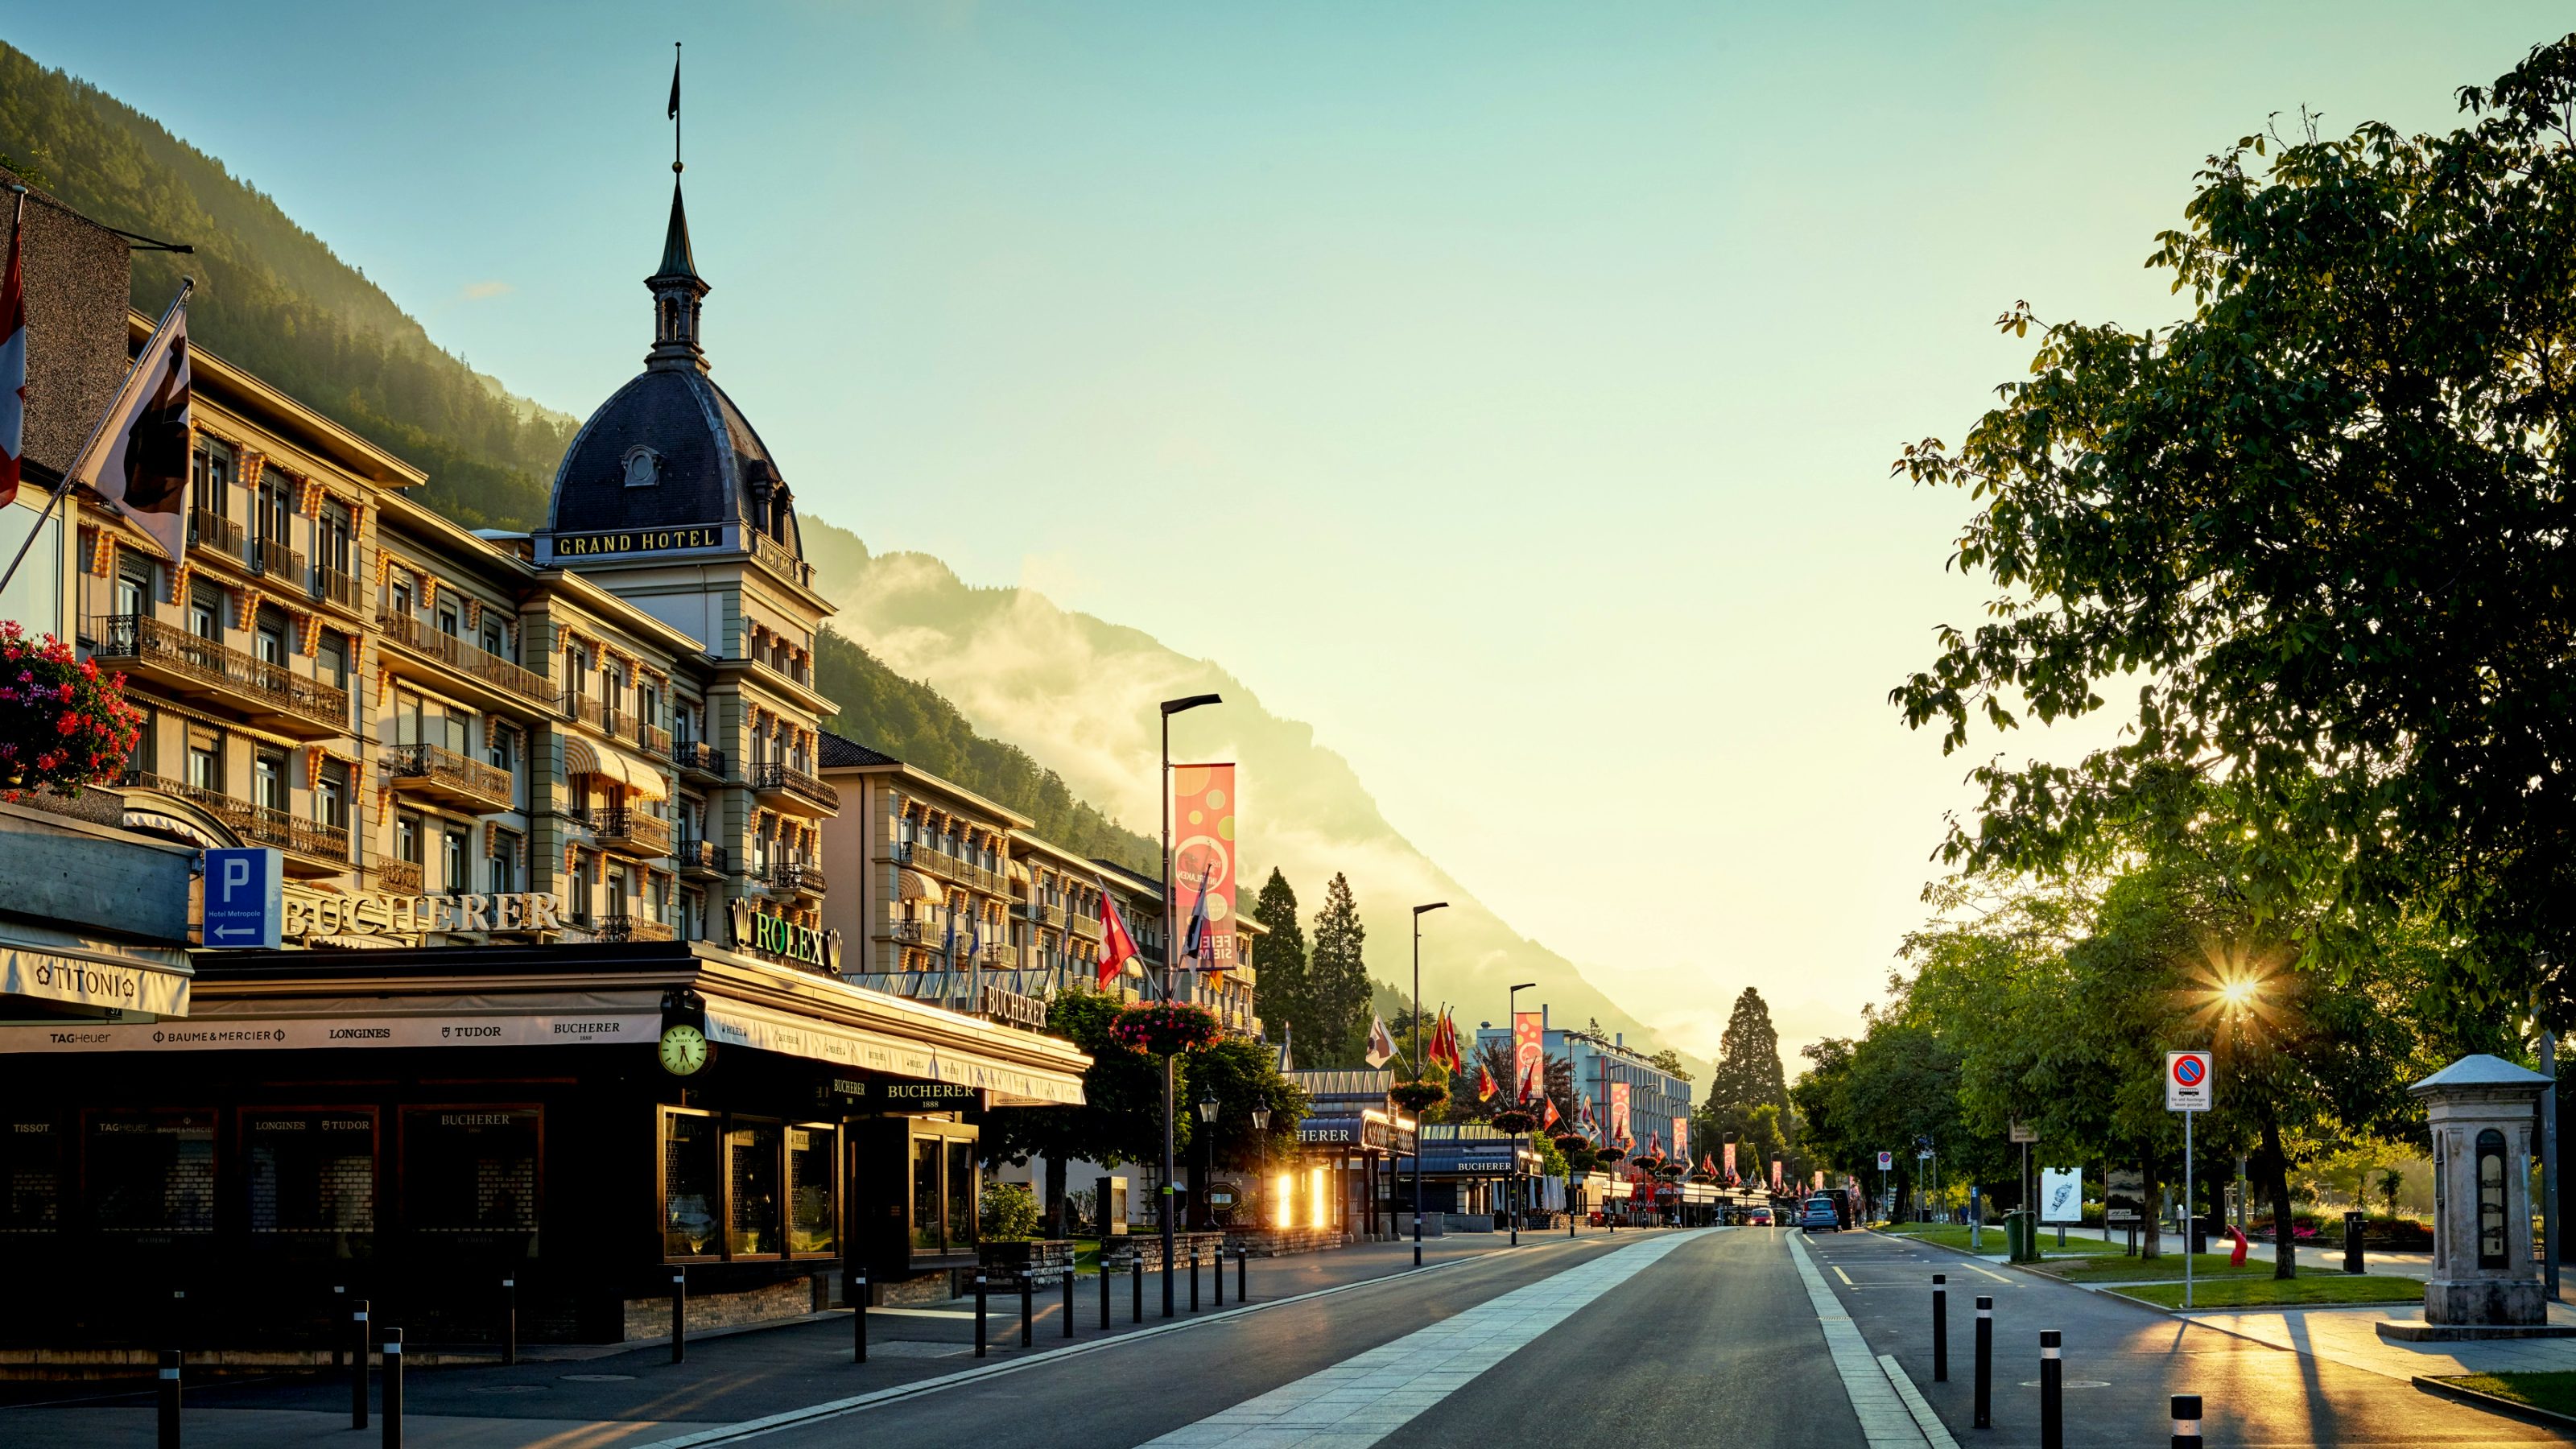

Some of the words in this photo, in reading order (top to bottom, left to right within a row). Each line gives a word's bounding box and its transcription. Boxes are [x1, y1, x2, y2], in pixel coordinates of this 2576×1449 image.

[560, 534, 631, 555] GRAND
[642, 529, 715, 551] HOTEL
[760, 541, 795, 580] VICTORIA
[223, 857, 250, 902] P
[208, 910, 225, 919] Hotel
[227, 909, 261, 919] Metropole
[282, 892, 562, 937] BUCHERER
[755, 911, 825, 967] ROLEX
[53, 965, 120, 998] TITONI
[988, 985, 1047, 1029] BUCHERER
[329, 1028, 390, 1039] LONGINES
[455, 1026, 502, 1038] TUDOR
[554, 1022, 621, 1034] BUCHERER
[726, 1025, 744, 1037] ROLEX
[833, 1079, 865, 1096] BUCHERER
[887, 1084, 976, 1099] BUCHERER
[922, 1100, 939, 1108] 1888
[255, 1121, 307, 1131] LONGINES
[332, 1120, 369, 1131] TUDOR
[441, 1114, 510, 1126] BUCHERER
[13, 1123, 50, 1133] TISSOT
[1458, 1162, 1512, 1171] BUCHERER
